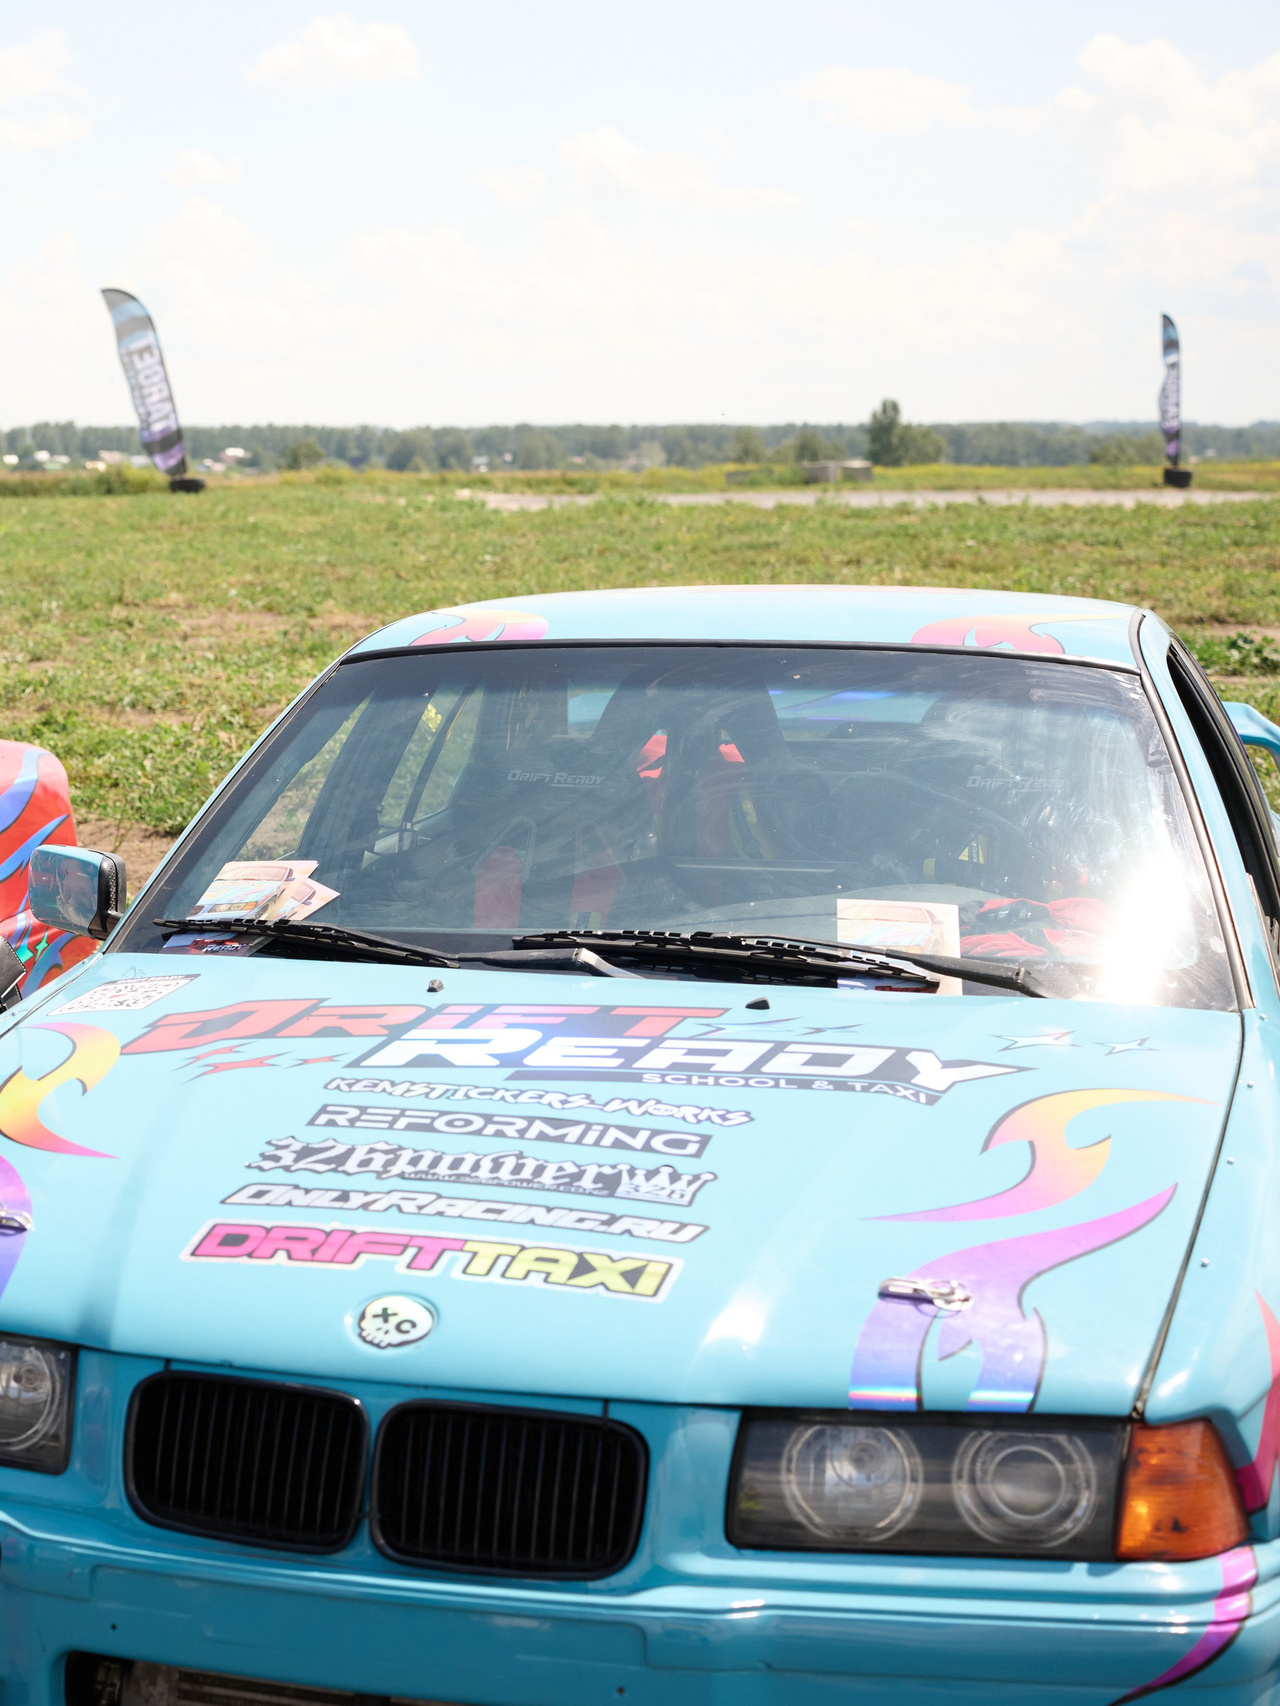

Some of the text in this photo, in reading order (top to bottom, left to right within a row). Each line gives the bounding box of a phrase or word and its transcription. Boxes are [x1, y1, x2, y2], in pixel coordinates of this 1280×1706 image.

[506, 770, 605, 785] DRIFT READY
[121, 998, 730, 1054] DRIFT
[358, 1027, 1022, 1094] READY
[641, 1072, 927, 1104] SCHOOL & TAXI
